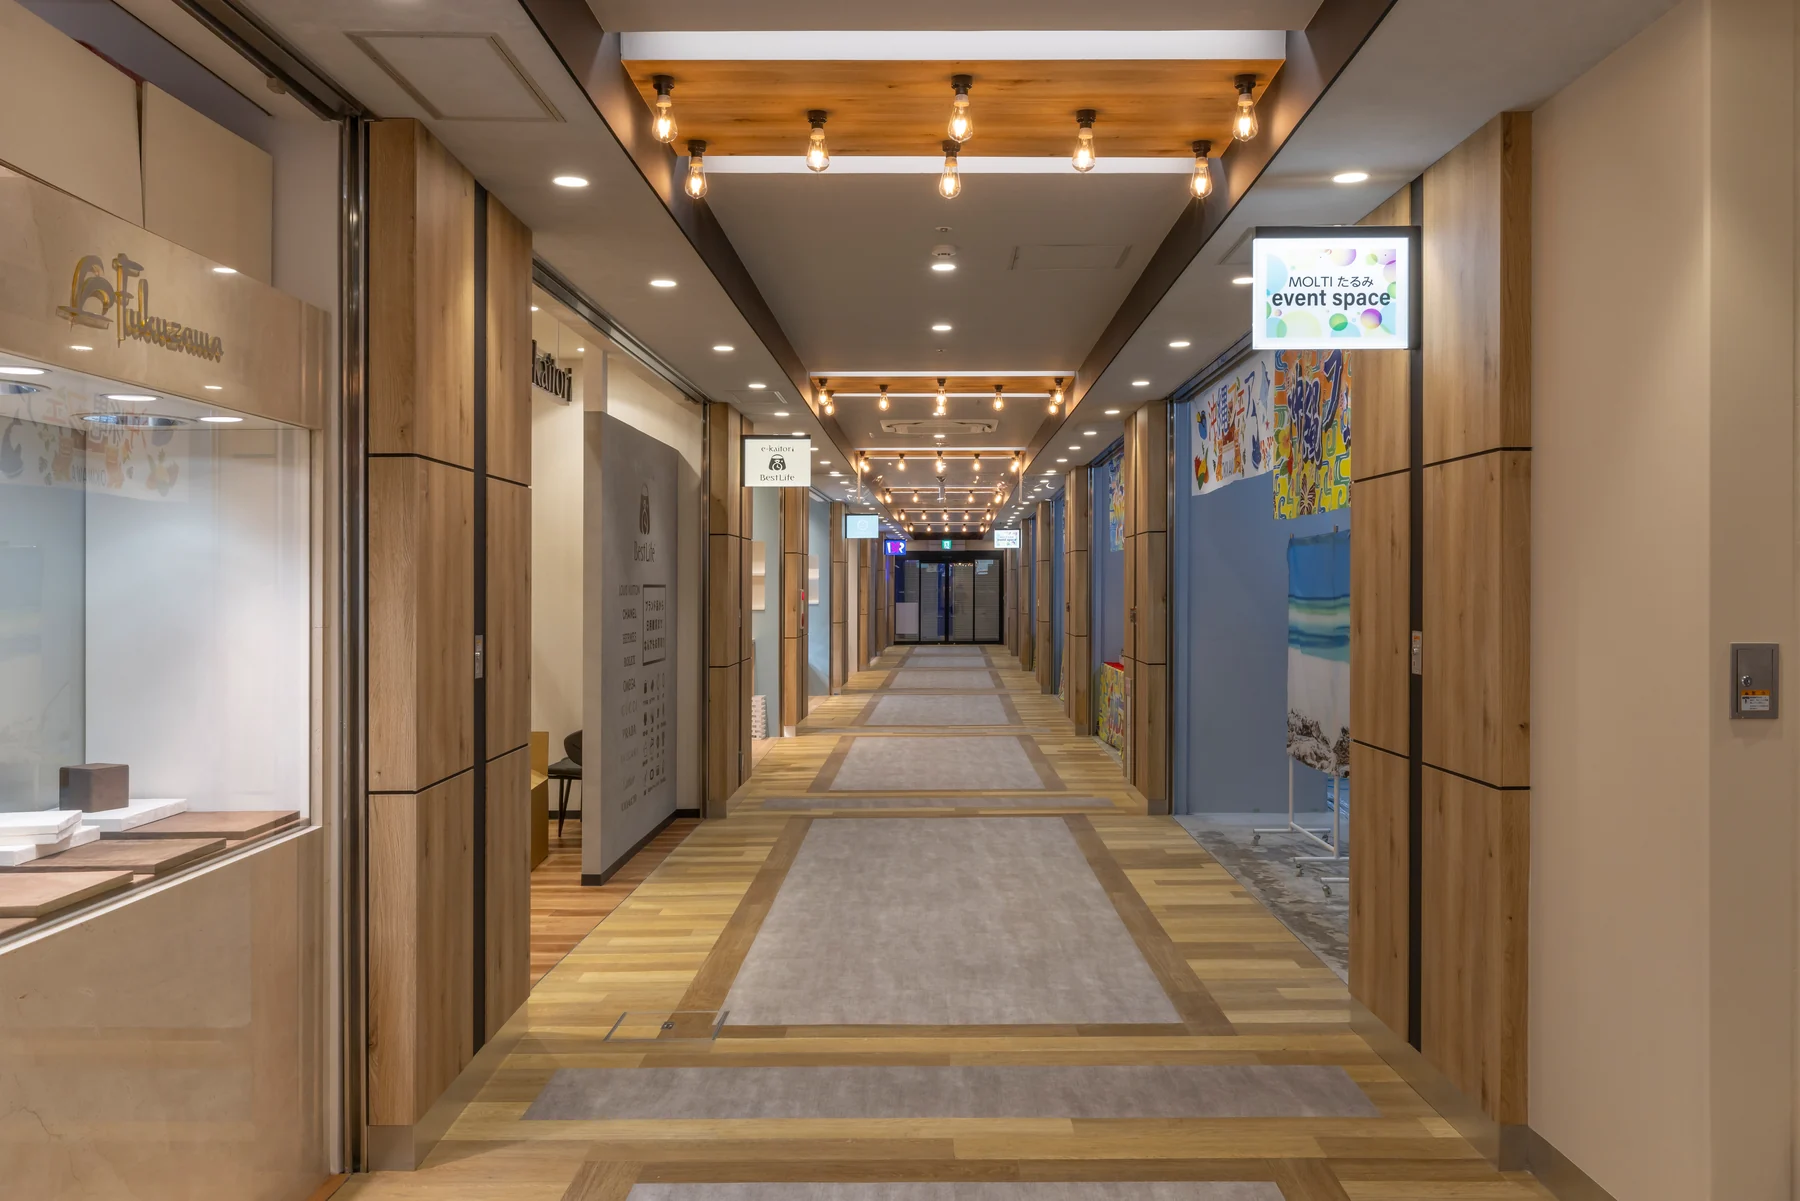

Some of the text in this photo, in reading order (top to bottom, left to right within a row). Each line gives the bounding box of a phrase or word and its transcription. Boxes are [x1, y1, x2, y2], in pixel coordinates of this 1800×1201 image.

[1288, 276, 1374, 288] MOLTI たるみ
[112, 253, 224, 358] Fukuzawa
[1272, 289, 1391, 311] event space
[1207, 370, 1256, 442] 沖縄フェア
[622, 608, 637, 620] CHANEL
